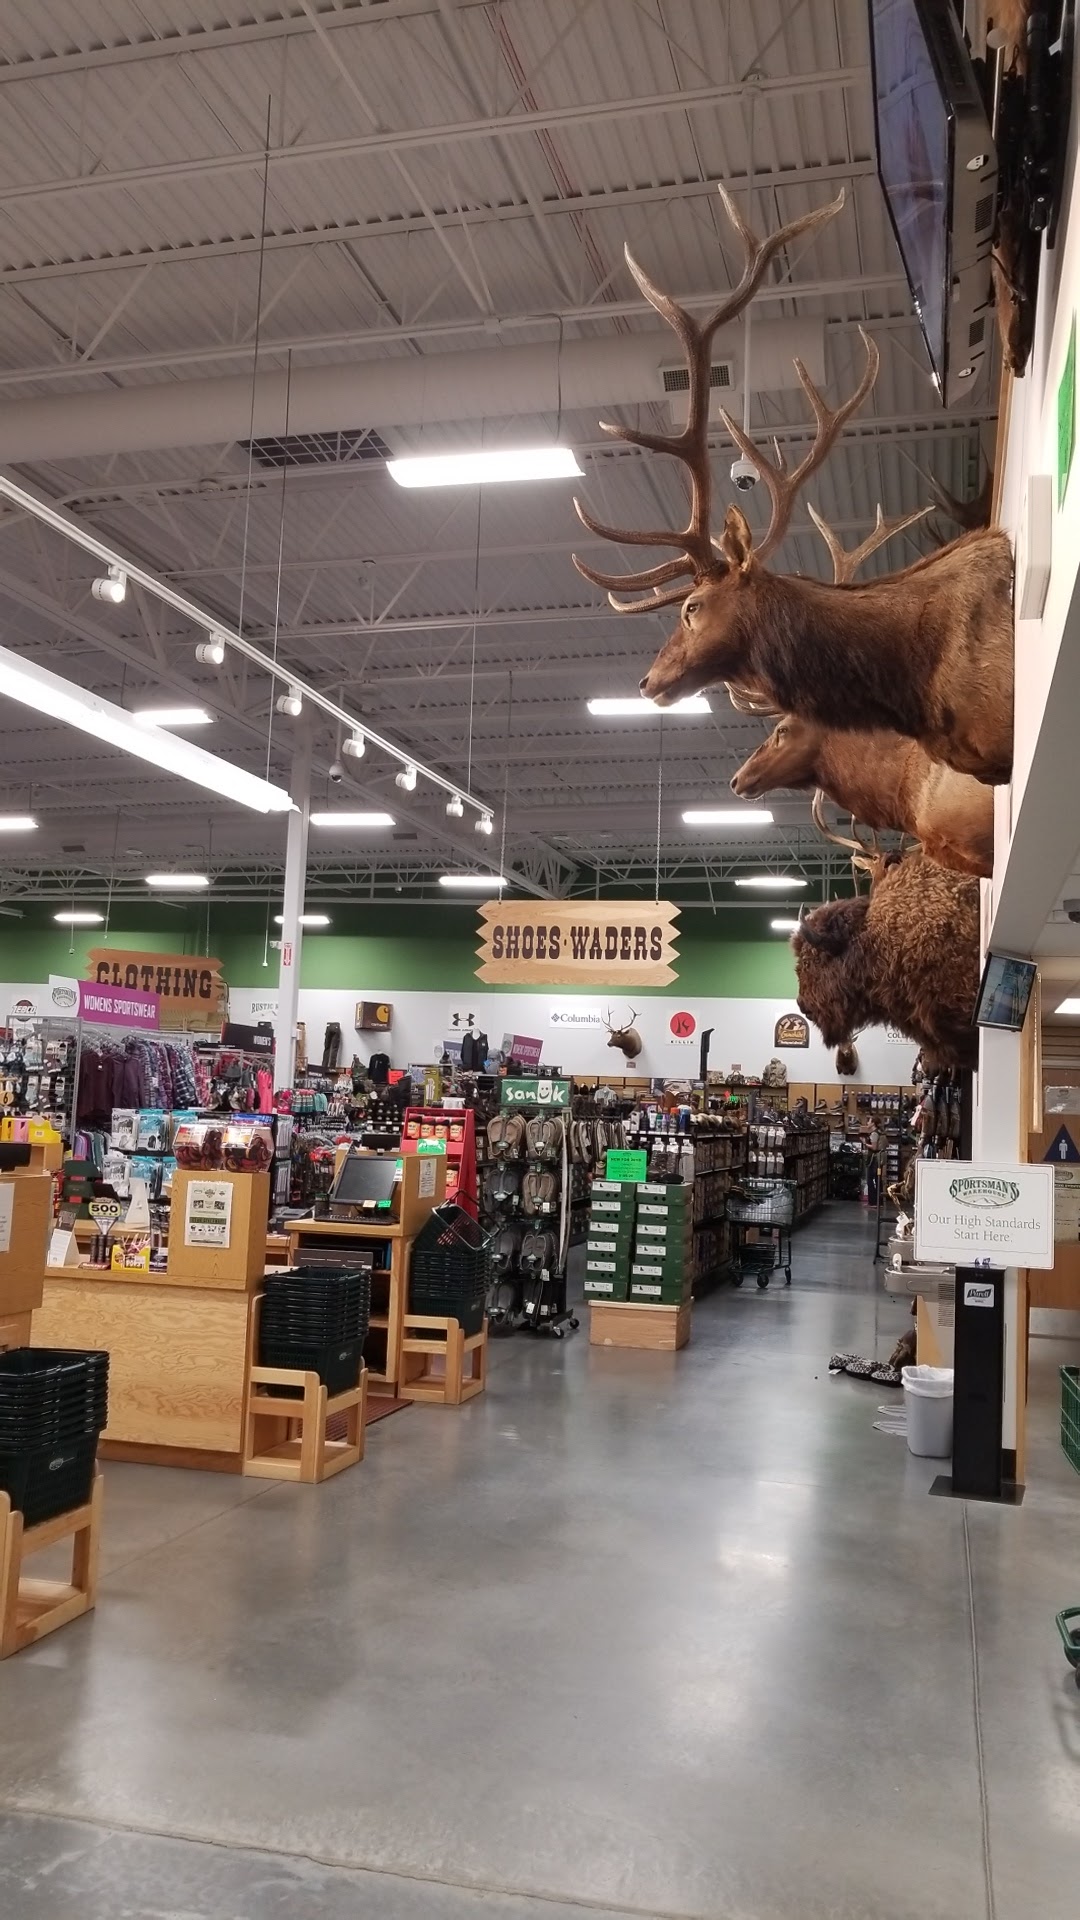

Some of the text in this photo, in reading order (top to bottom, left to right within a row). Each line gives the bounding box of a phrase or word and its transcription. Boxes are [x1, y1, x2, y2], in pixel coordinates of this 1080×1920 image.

[492, 925, 662, 960] SHOES WADERS
[96, 961, 212, 998] CLOTHING
[84, 994, 156, 1018] WOMENS SPORTSWEAR
[251, 1003, 274, 1014] RUSTIC
[560, 1013, 600, 1023] Columbia
[949, 1178, 1020, 1201] SPORTSMAN'S
[962, 1189, 1007, 1199] WAREHOUSE
[91, 1204, 118, 1212] 500
[928, 1213, 1041, 1230] Our High Standards
[954, 1228, 979, 1240] Start
